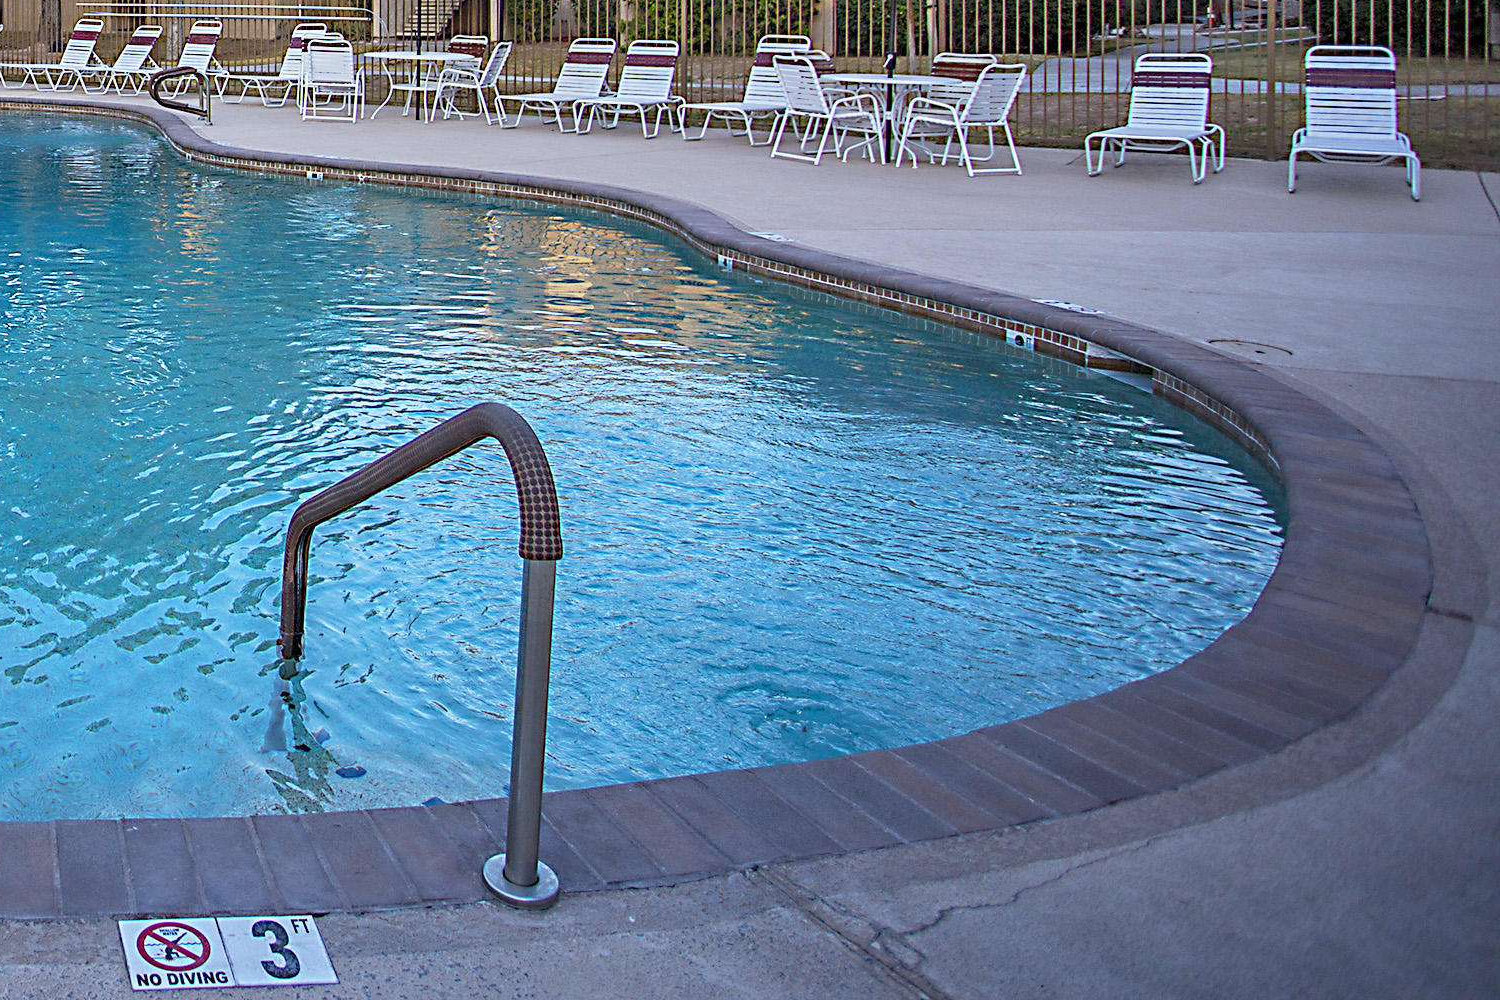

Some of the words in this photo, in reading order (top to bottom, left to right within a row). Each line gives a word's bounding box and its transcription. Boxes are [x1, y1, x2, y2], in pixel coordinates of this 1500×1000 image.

[252, 920, 300, 979] 3
[290, 918, 310, 934] FT
[136, 973, 162, 986] NO
[166, 971, 229, 986] DIVING
